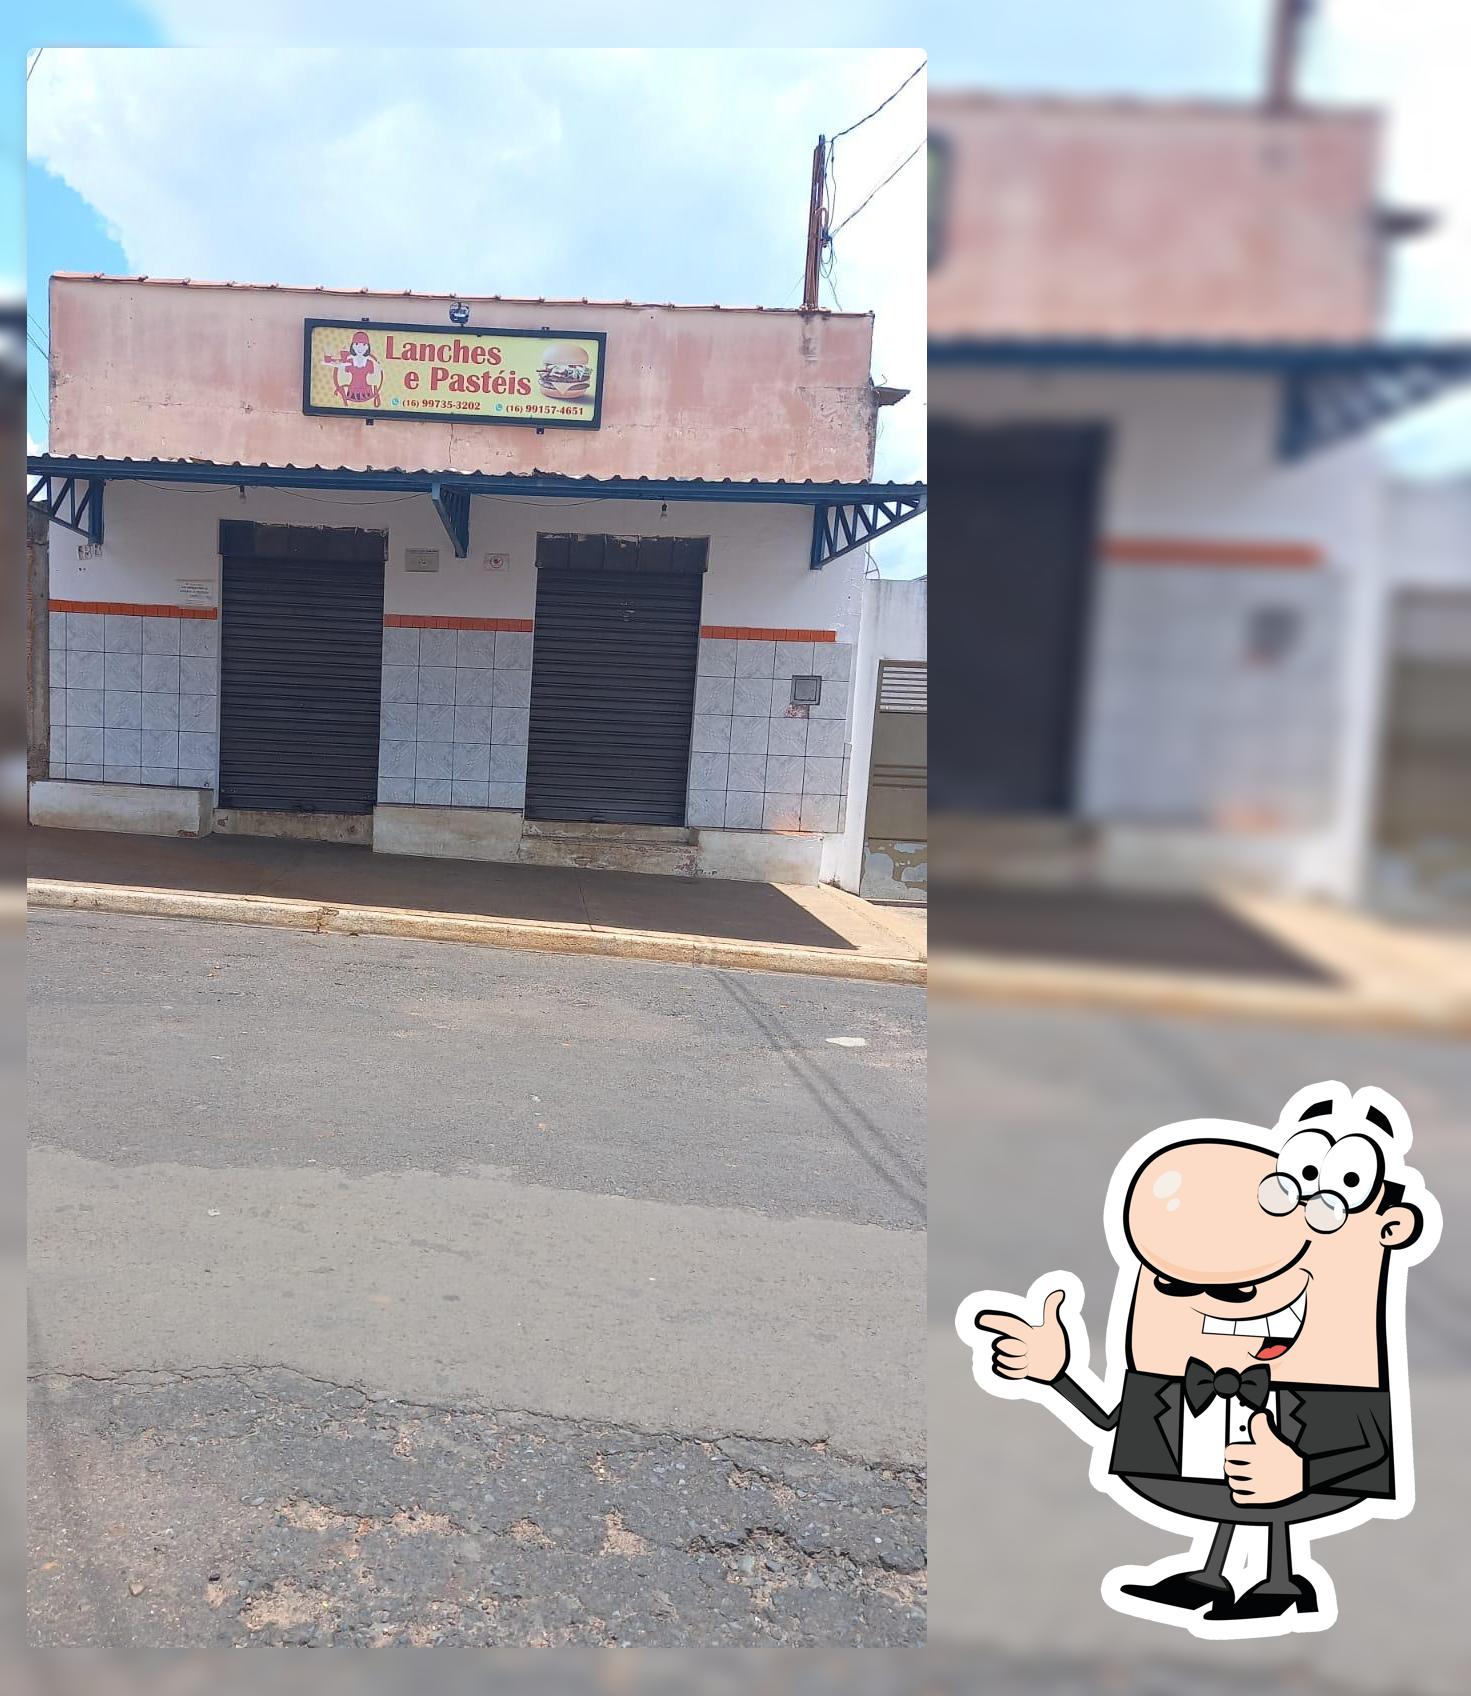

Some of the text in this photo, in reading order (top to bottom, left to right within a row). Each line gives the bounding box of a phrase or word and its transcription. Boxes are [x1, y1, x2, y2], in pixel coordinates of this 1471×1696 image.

[386, 335, 502, 365] Lanches
[404, 367, 531, 395] e Pastéis
[402, 399, 583, 415] (16) 99735-3202 (16) 99157-4651
